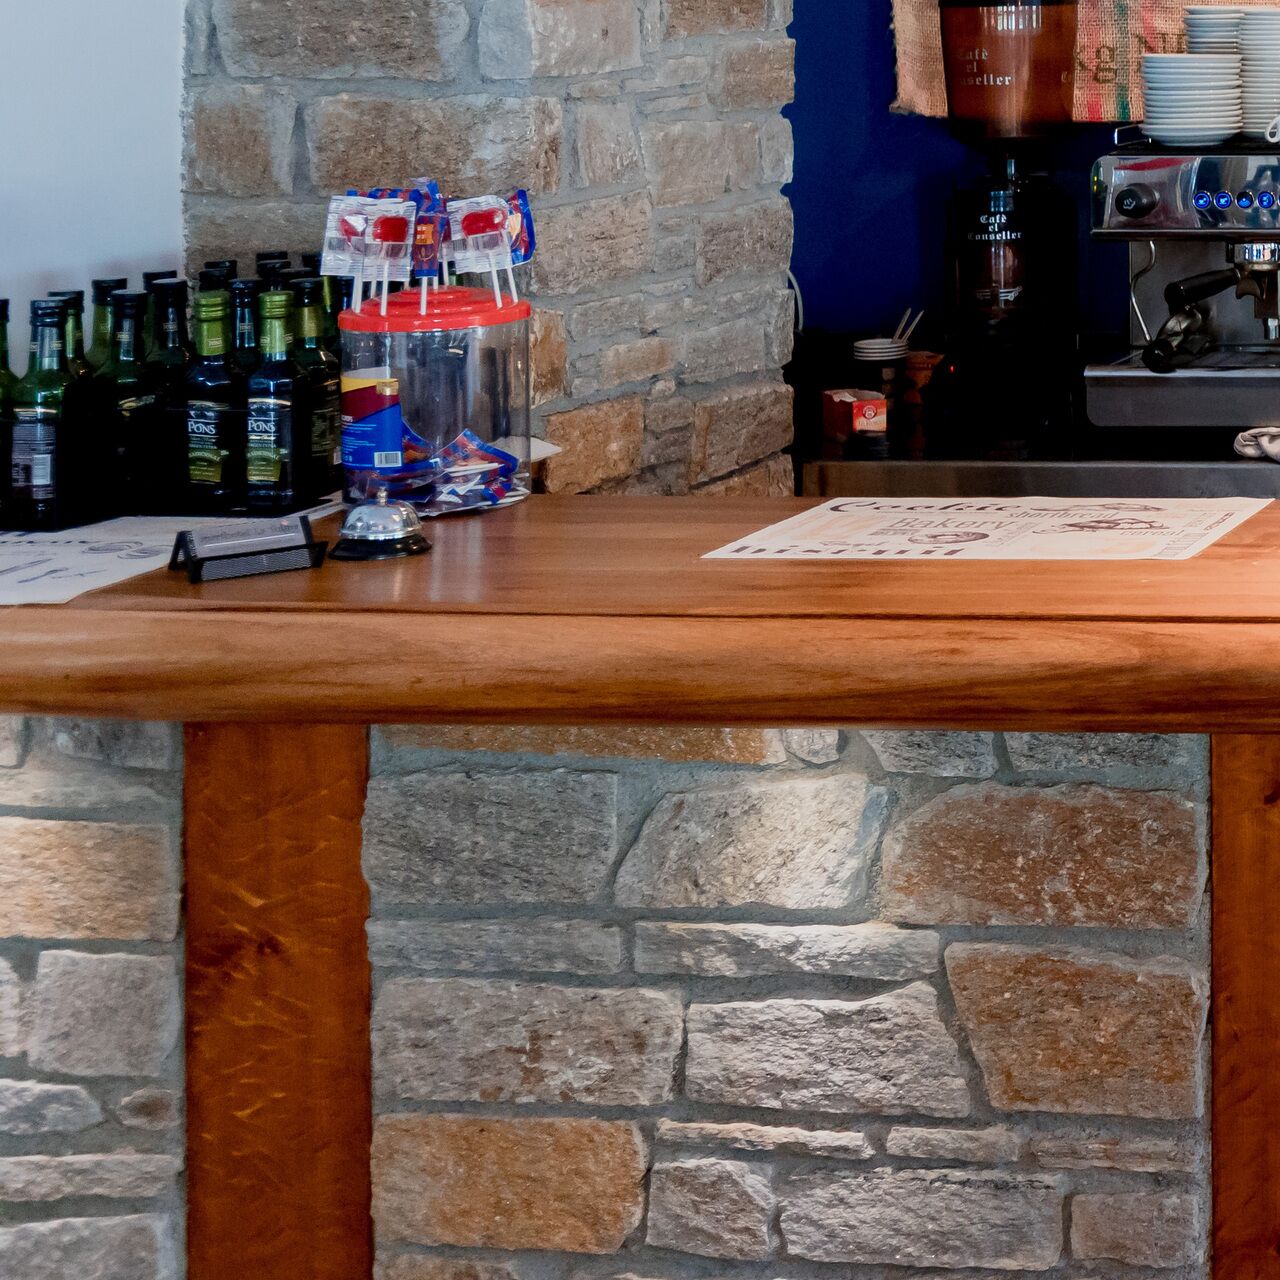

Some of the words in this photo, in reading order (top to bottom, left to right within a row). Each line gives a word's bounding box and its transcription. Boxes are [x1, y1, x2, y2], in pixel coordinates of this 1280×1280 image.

[188, 421, 216, 434] PONS
[248, 420, 276, 432] PONS
[888, 517, 1016, 530] Bakery
